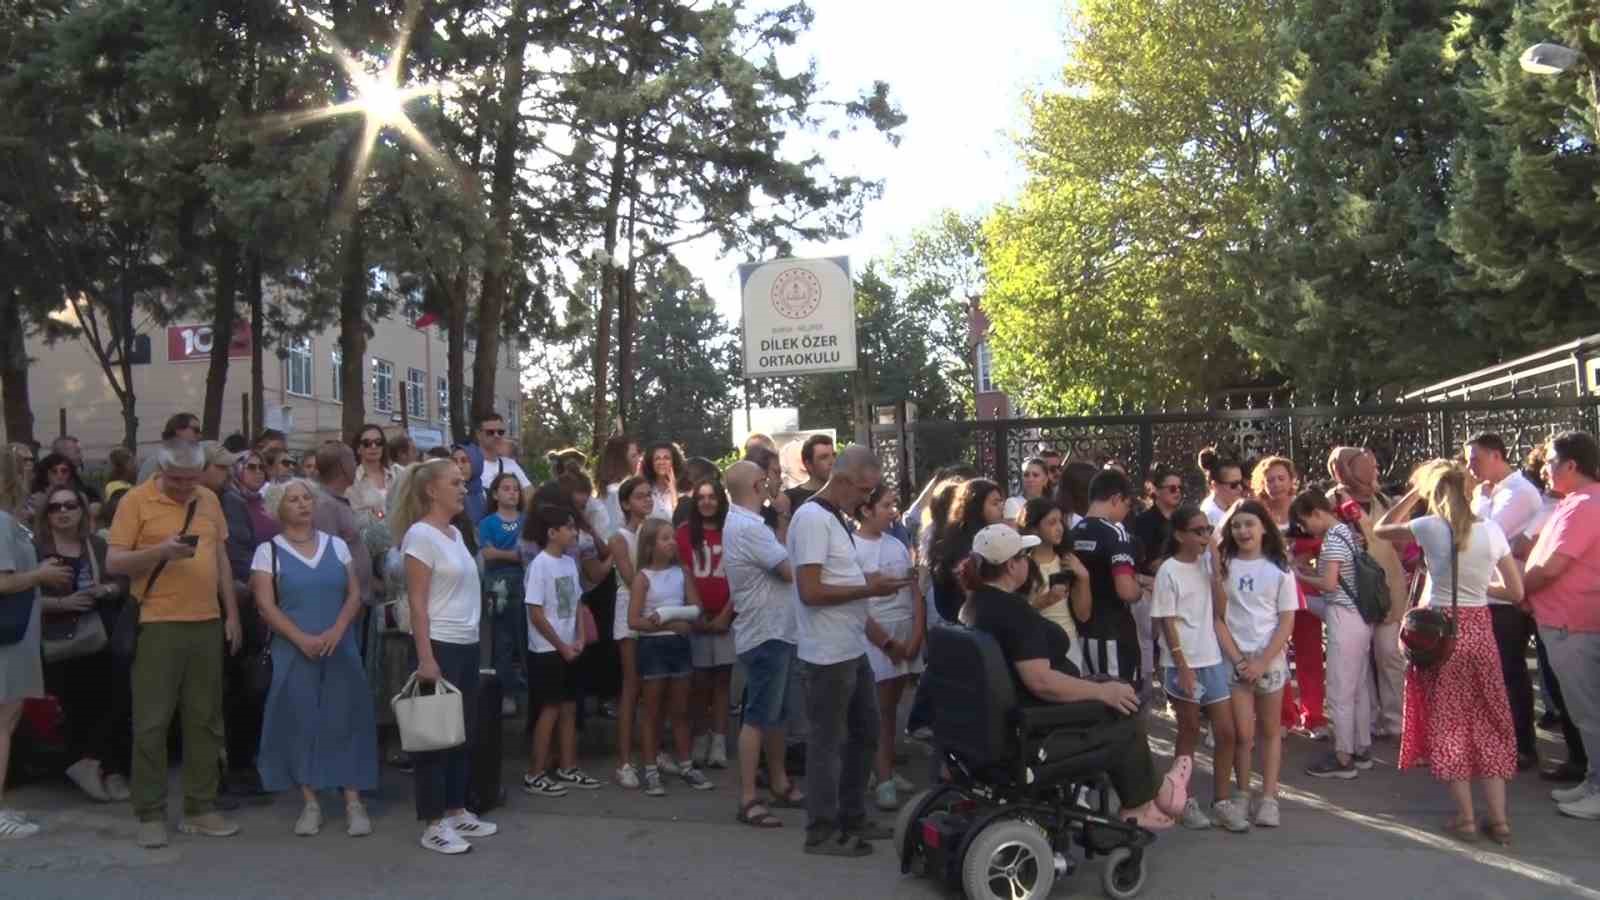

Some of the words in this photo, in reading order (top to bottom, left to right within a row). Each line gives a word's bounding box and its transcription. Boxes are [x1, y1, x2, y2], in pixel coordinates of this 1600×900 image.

[181, 327, 214, 355] 10
[761, 336, 799, 351] DİLEK
[802, 335, 838, 348] ÖZER
[759, 351, 840, 367] ORTAOKULU
[1239, 577, 1254, 591] M
